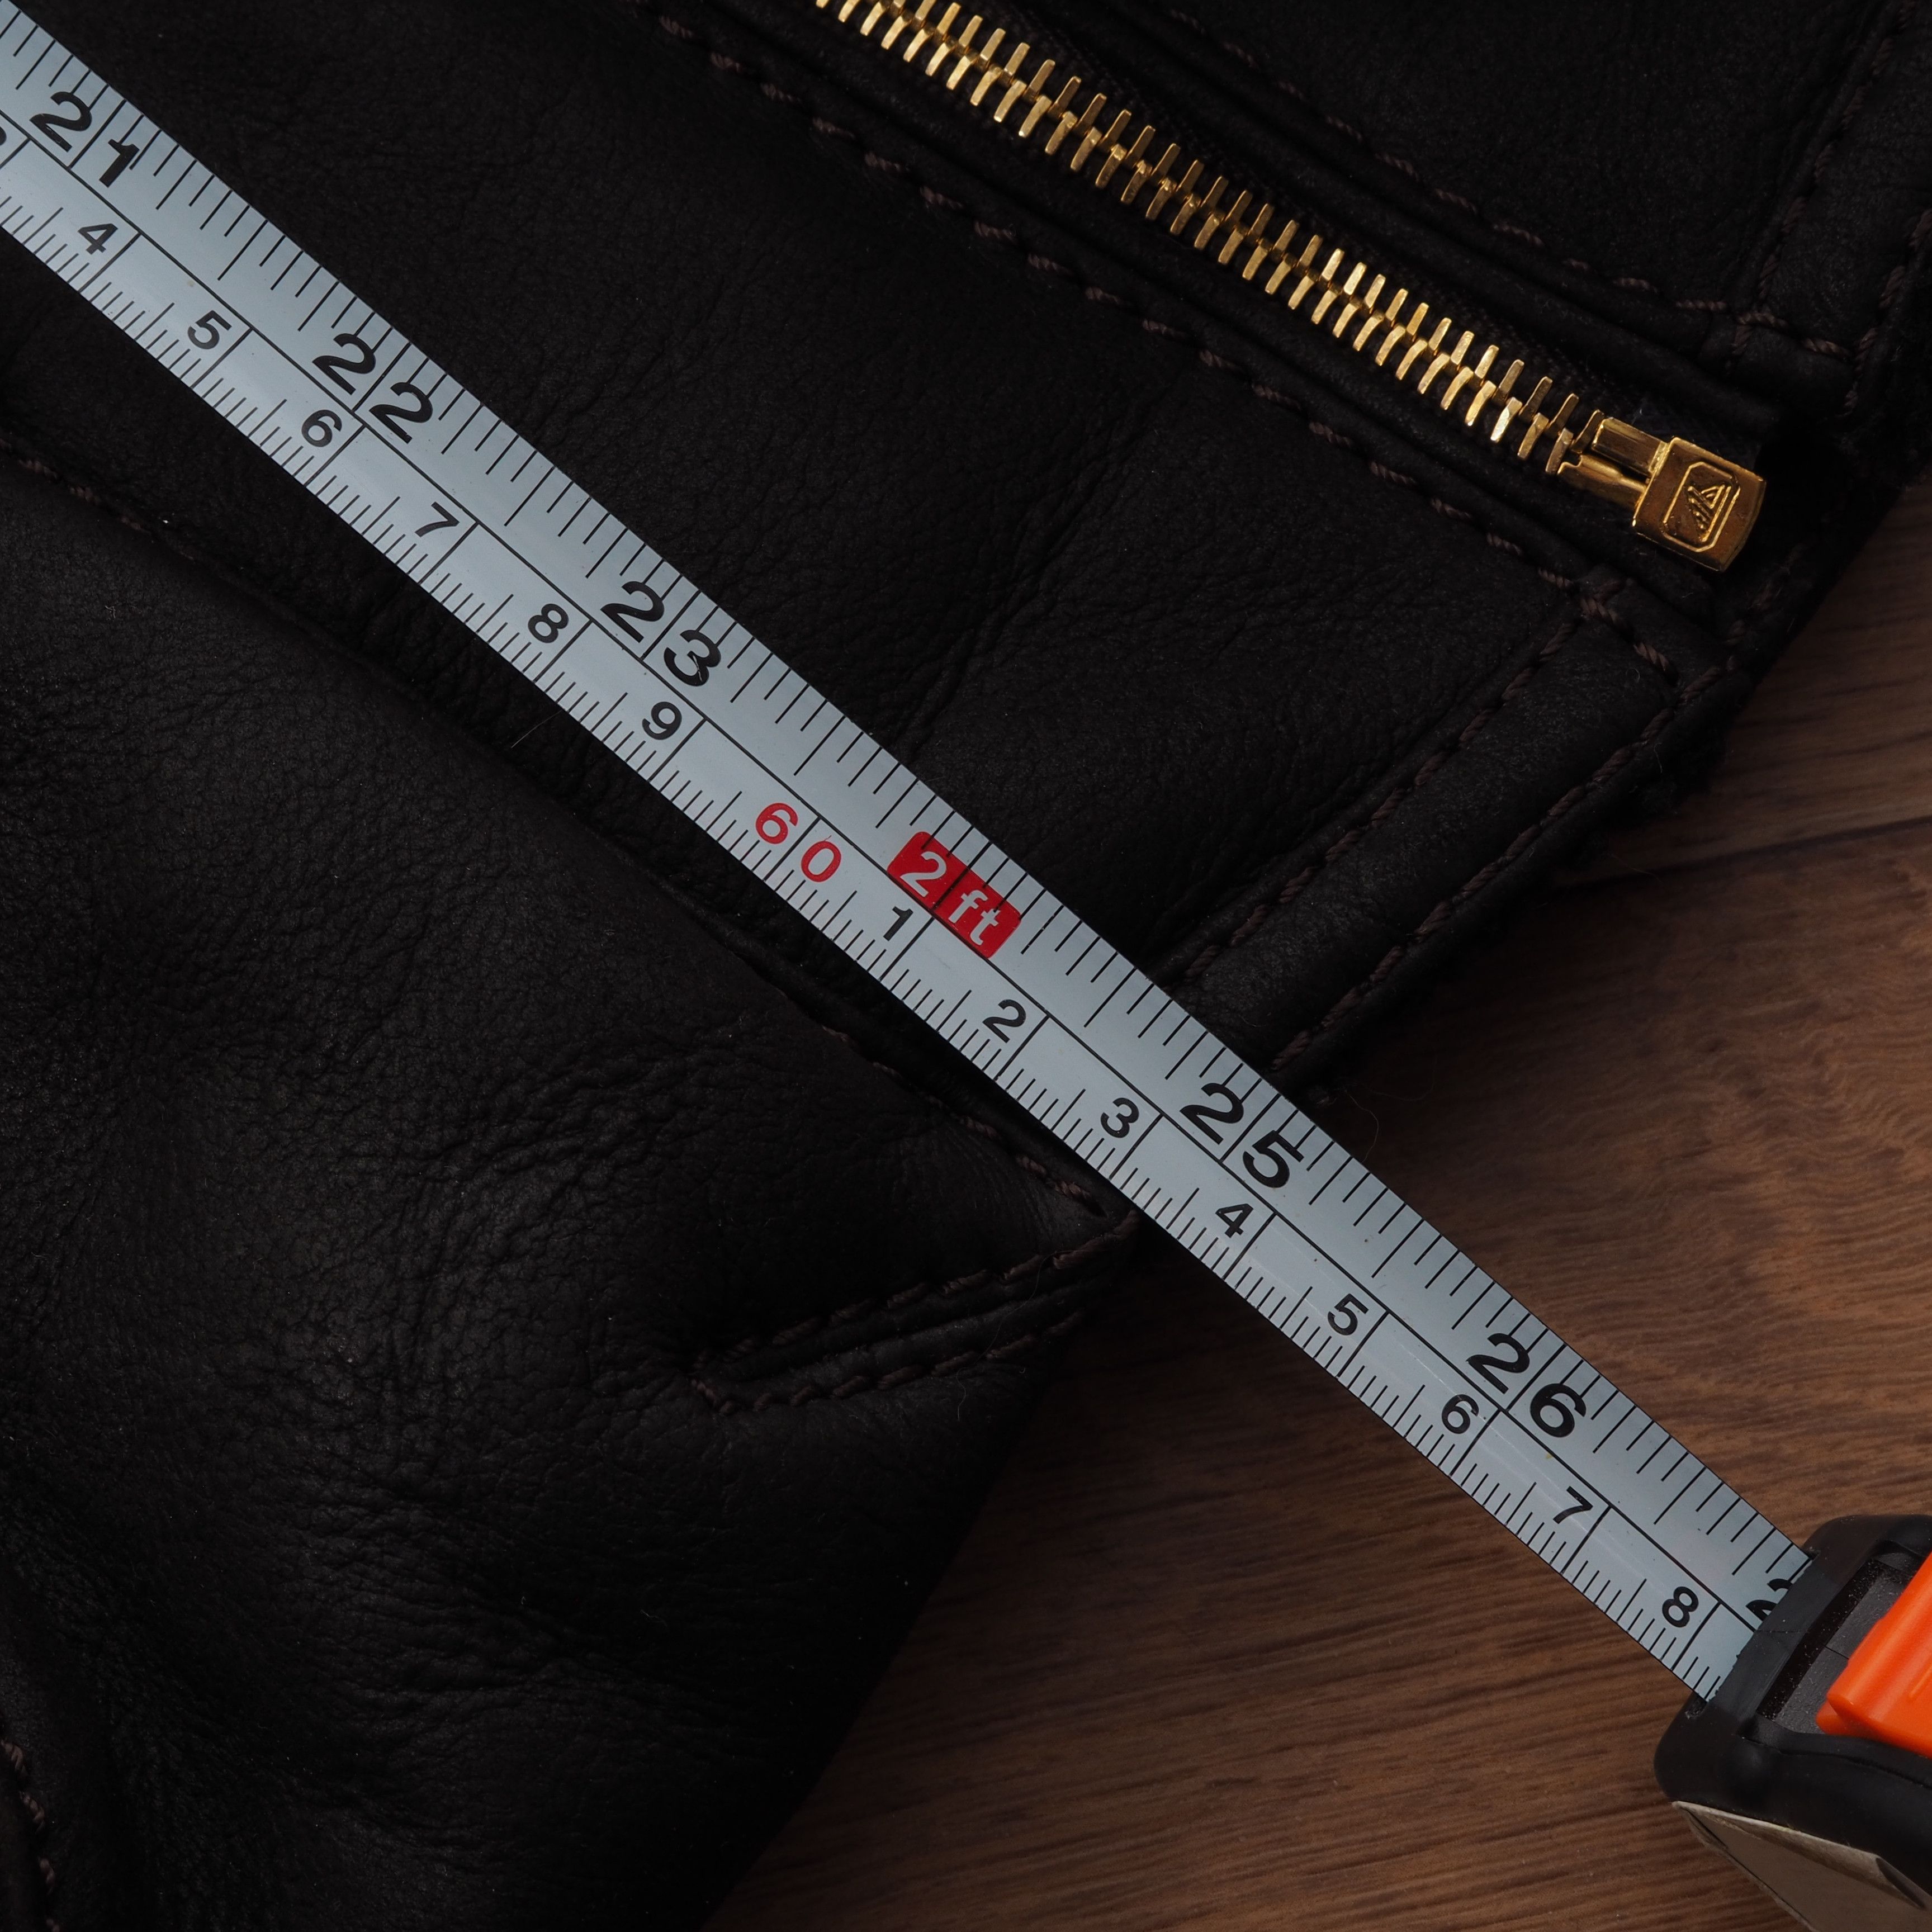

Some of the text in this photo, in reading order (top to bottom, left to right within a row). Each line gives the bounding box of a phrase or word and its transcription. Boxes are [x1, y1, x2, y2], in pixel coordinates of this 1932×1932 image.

[30, 91, 140, 187] 21
[77, 223, 118, 254] 4
[187, 310, 232, 349] 5
[312, 333, 433, 444] 22
[301, 409, 342, 447] 6
[415, 501, 460, 538] 7
[528, 603, 569, 643] 8
[600, 581, 721, 686] 23
[642, 702, 682, 740] 9
[755, 802, 842, 883] 60
[883, 906, 913, 941] 1
[982, 999, 1026, 1043] 2
[1100, 1097, 1140, 1138] 3
[1180, 1082, 1304, 1188] 25
[1215, 1203, 1254, 1238] 4
[1327, 1293, 1369, 1336] 5
[1466, 1332, 1587, 1438] 26
[1441, 1394, 1479, 1434] 6
[1552, 1486, 1593, 1524] 7
[1661, 1586, 1699, 1628] 8
